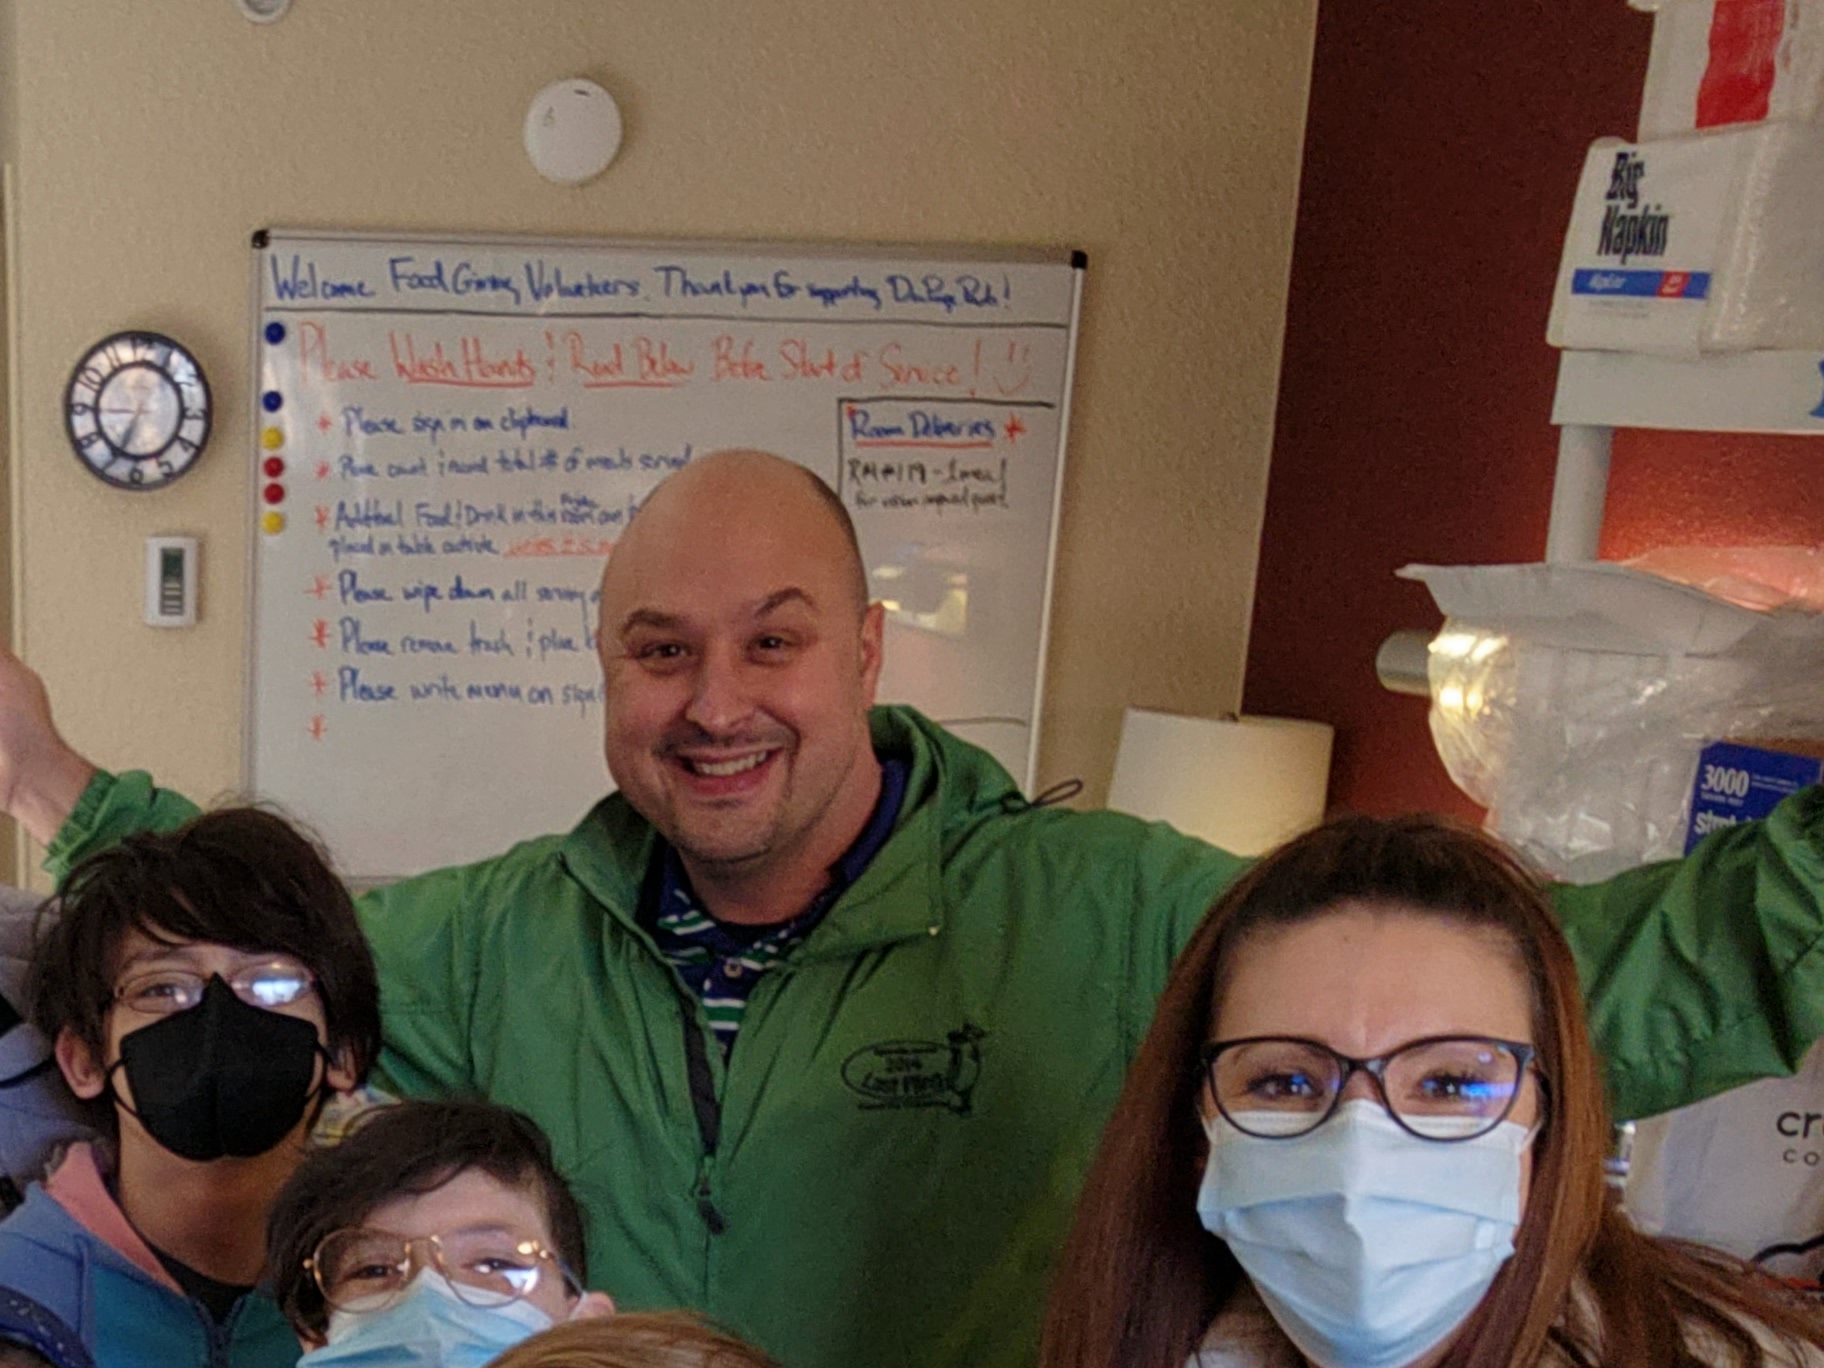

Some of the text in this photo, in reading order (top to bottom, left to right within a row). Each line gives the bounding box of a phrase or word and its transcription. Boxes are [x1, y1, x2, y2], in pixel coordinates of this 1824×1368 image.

[1606, 152, 1645, 209] Big
[1596, 203, 1669, 264] Napkin
[270, 254, 375, 300] Welcome
[298, 321, 379, 384] Please
[563, 331, 623, 377] Read
[344, 406, 405, 436] Please
[850, 408, 905, 439] Room
[337, 569, 393, 603] Please
[402, 581, 442, 613] wipe
[501, 580, 527, 601] all
[338, 616, 394, 655] Please
[338, 665, 398, 701] Please
[1701, 765, 1749, 797] 3000
[1776, 1111, 1824, 1139] cr
